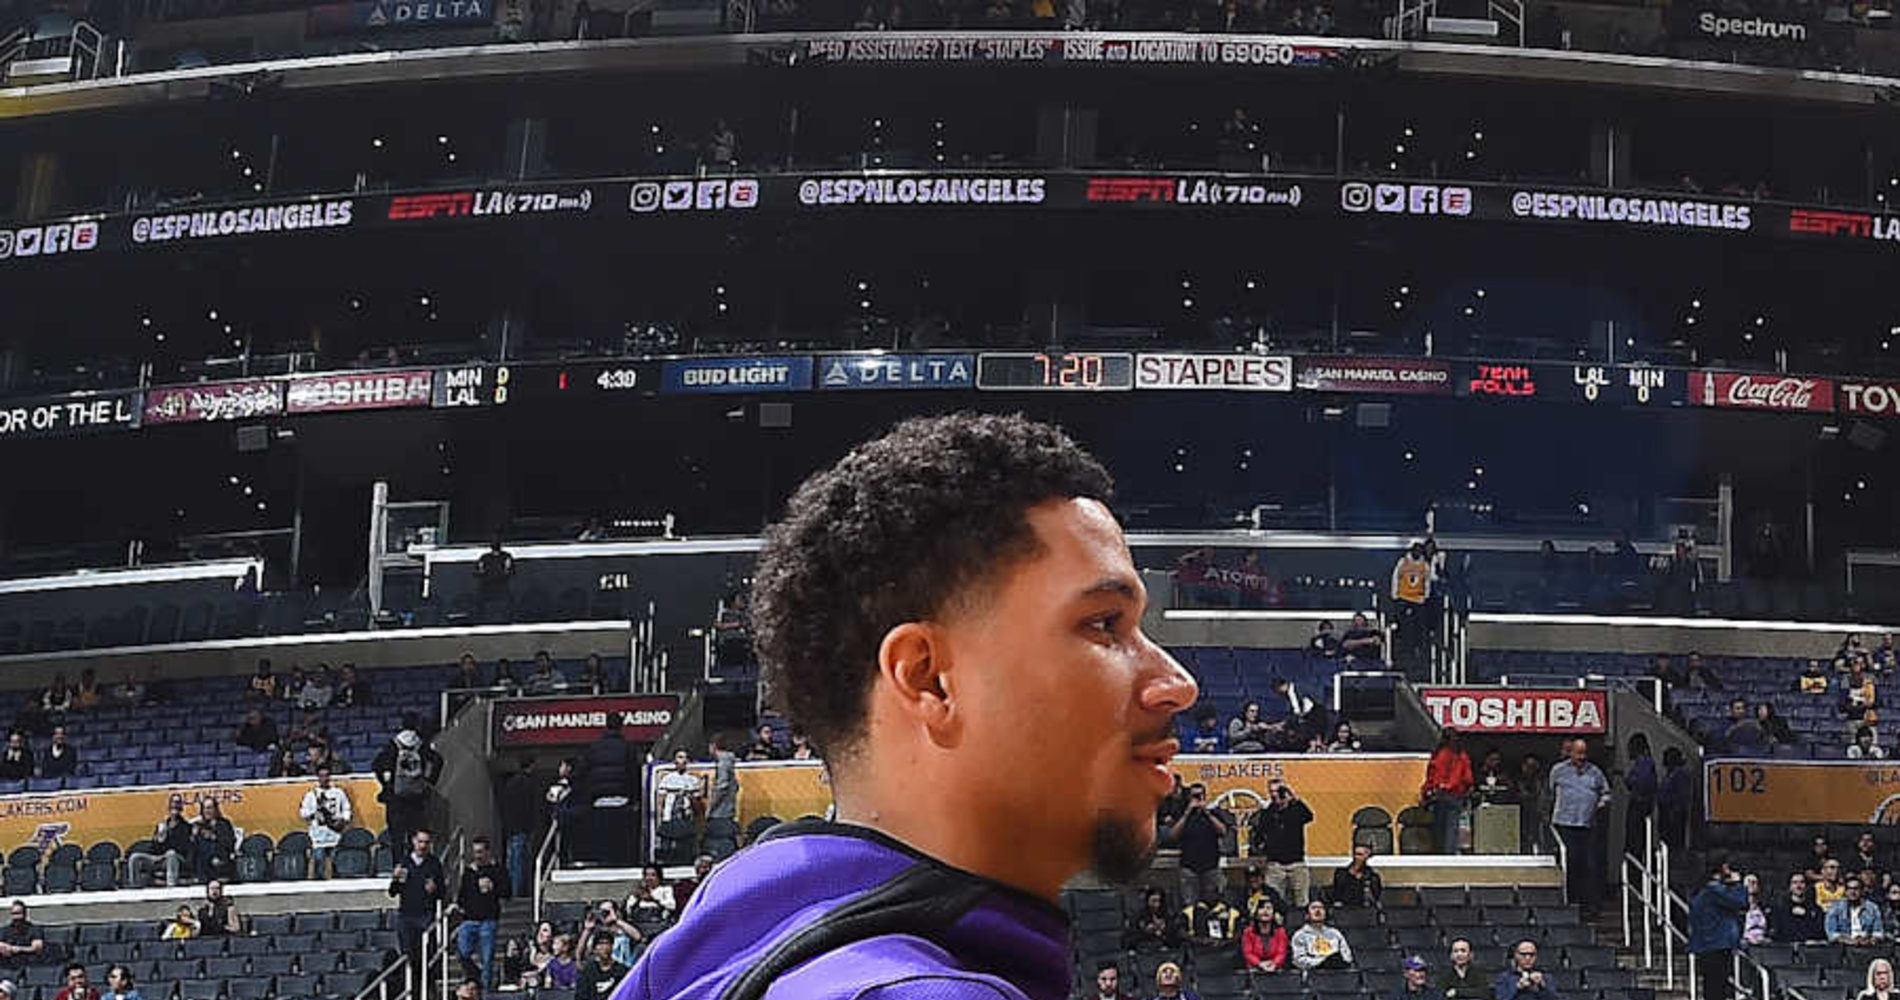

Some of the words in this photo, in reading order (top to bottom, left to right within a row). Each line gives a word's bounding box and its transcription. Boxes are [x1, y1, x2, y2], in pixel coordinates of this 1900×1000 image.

[395, 1, 483, 21] DELTA
[1700, 12, 1806, 40] Spectrum
[942, 39, 976, 60] TEXT
[1063, 40, 1103, 61] ISSUE
[1130, 41, 1198, 62] LOCATION
[1200, 44, 1218, 62] TO
[1221, 46, 1294, 65] 69050
[799, 178, 1046, 205] @ESPNLOSANGELES
[1087, 178, 1175, 202] ESPN
[388, 193, 473, 220] ESPN
[1513, 192, 1751, 231] @ESPNLOSANGELES
[133, 201, 354, 243] @ESPNLOSANGELES
[1790, 209, 1872, 238] ESPN
[446, 367, 482, 387] MIN
[683, 368, 727, 386] BUD
[728, 365, 789, 385] LIGHT
[860, 360, 968, 383] DELTA
[1139, 356, 1286, 388] STAPLES
[1317, 367, 1341, 380] SAN
[1343, 368, 1397, 382] MANUEL
[1398, 369, 1448, 383] CASINO
[1574, 366, 1610, 384] LAL
[1629, 369, 1665, 388] MIN
[446, 387, 480, 406] LAL
[31, 405, 63, 429] OF
[66, 401, 112, 427] THE
[516, 714, 547, 729] SAN
[1426, 695, 1602, 728] TOSHIBA
[1712, 766, 1767, 794] 102
